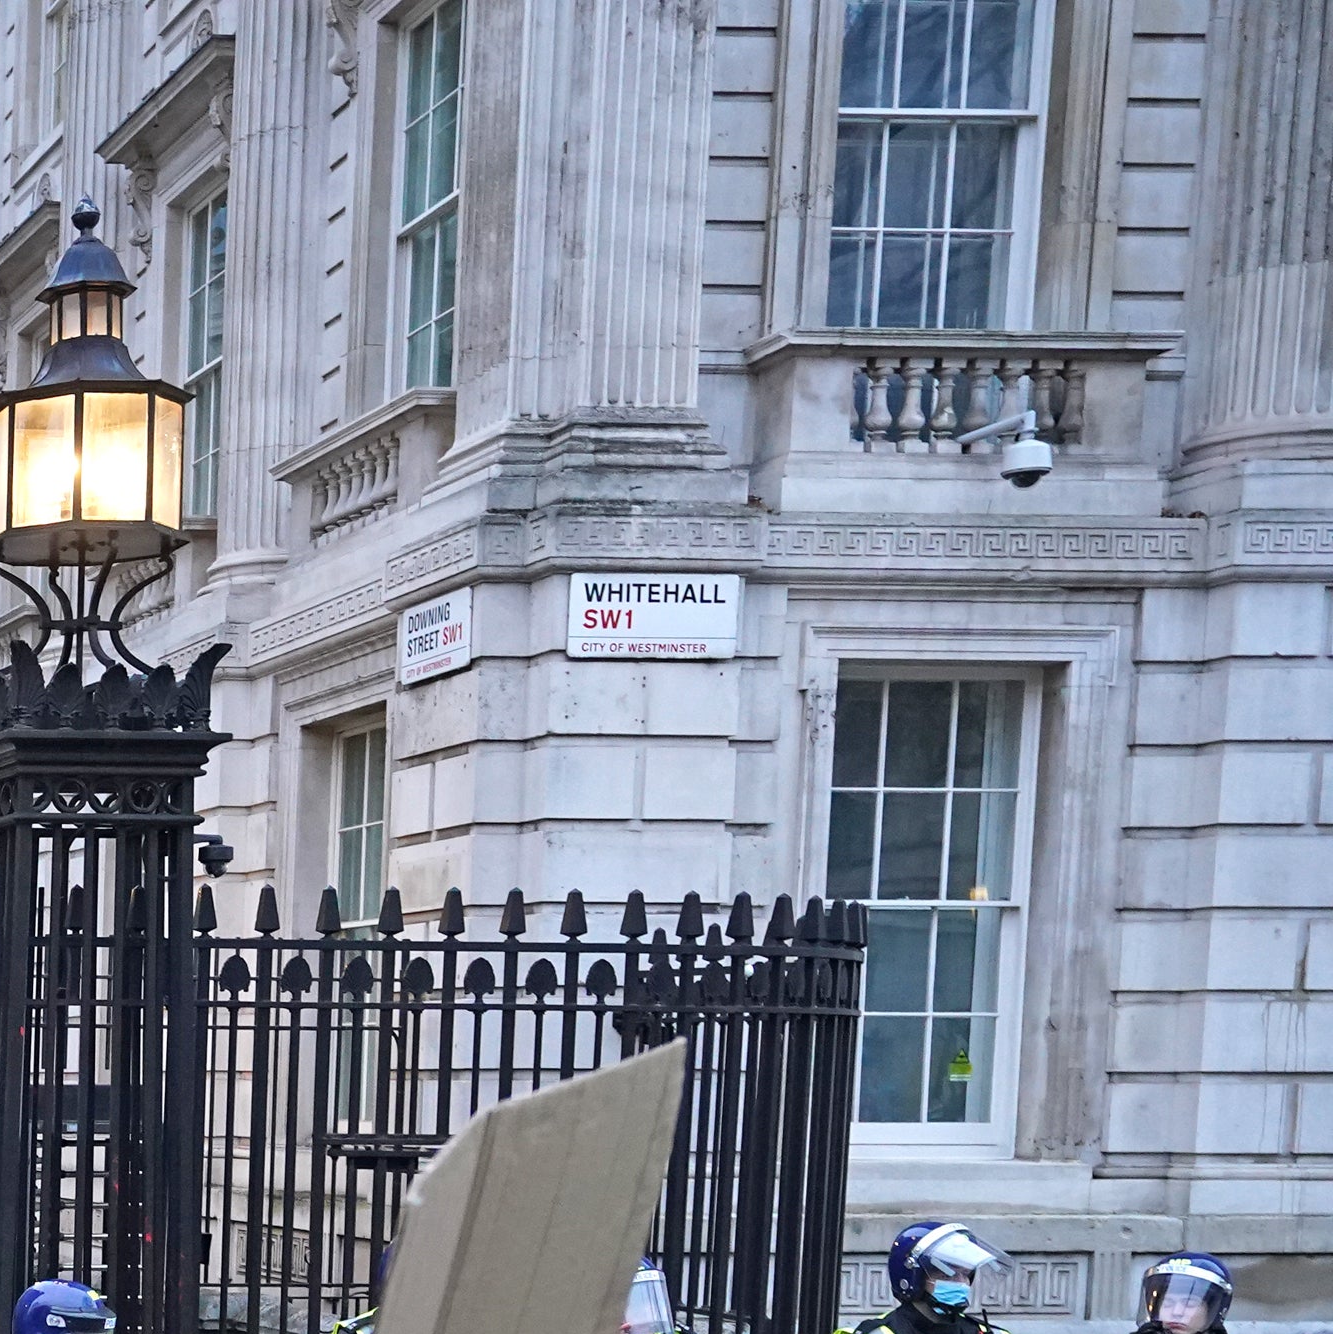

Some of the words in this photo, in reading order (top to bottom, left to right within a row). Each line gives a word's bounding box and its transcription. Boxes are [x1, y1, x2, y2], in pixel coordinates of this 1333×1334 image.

[585, 583, 726, 604] WHITEHALL
[408, 602, 450, 634] DOWNING
[583, 609, 633, 629] SW1
[407, 630, 440, 658] STREET
[442, 622, 463, 646] SW1
[582, 642, 606, 653] CITY
[609, 643, 624, 653] OF
[627, 643, 707, 653] WESTMINSTER
